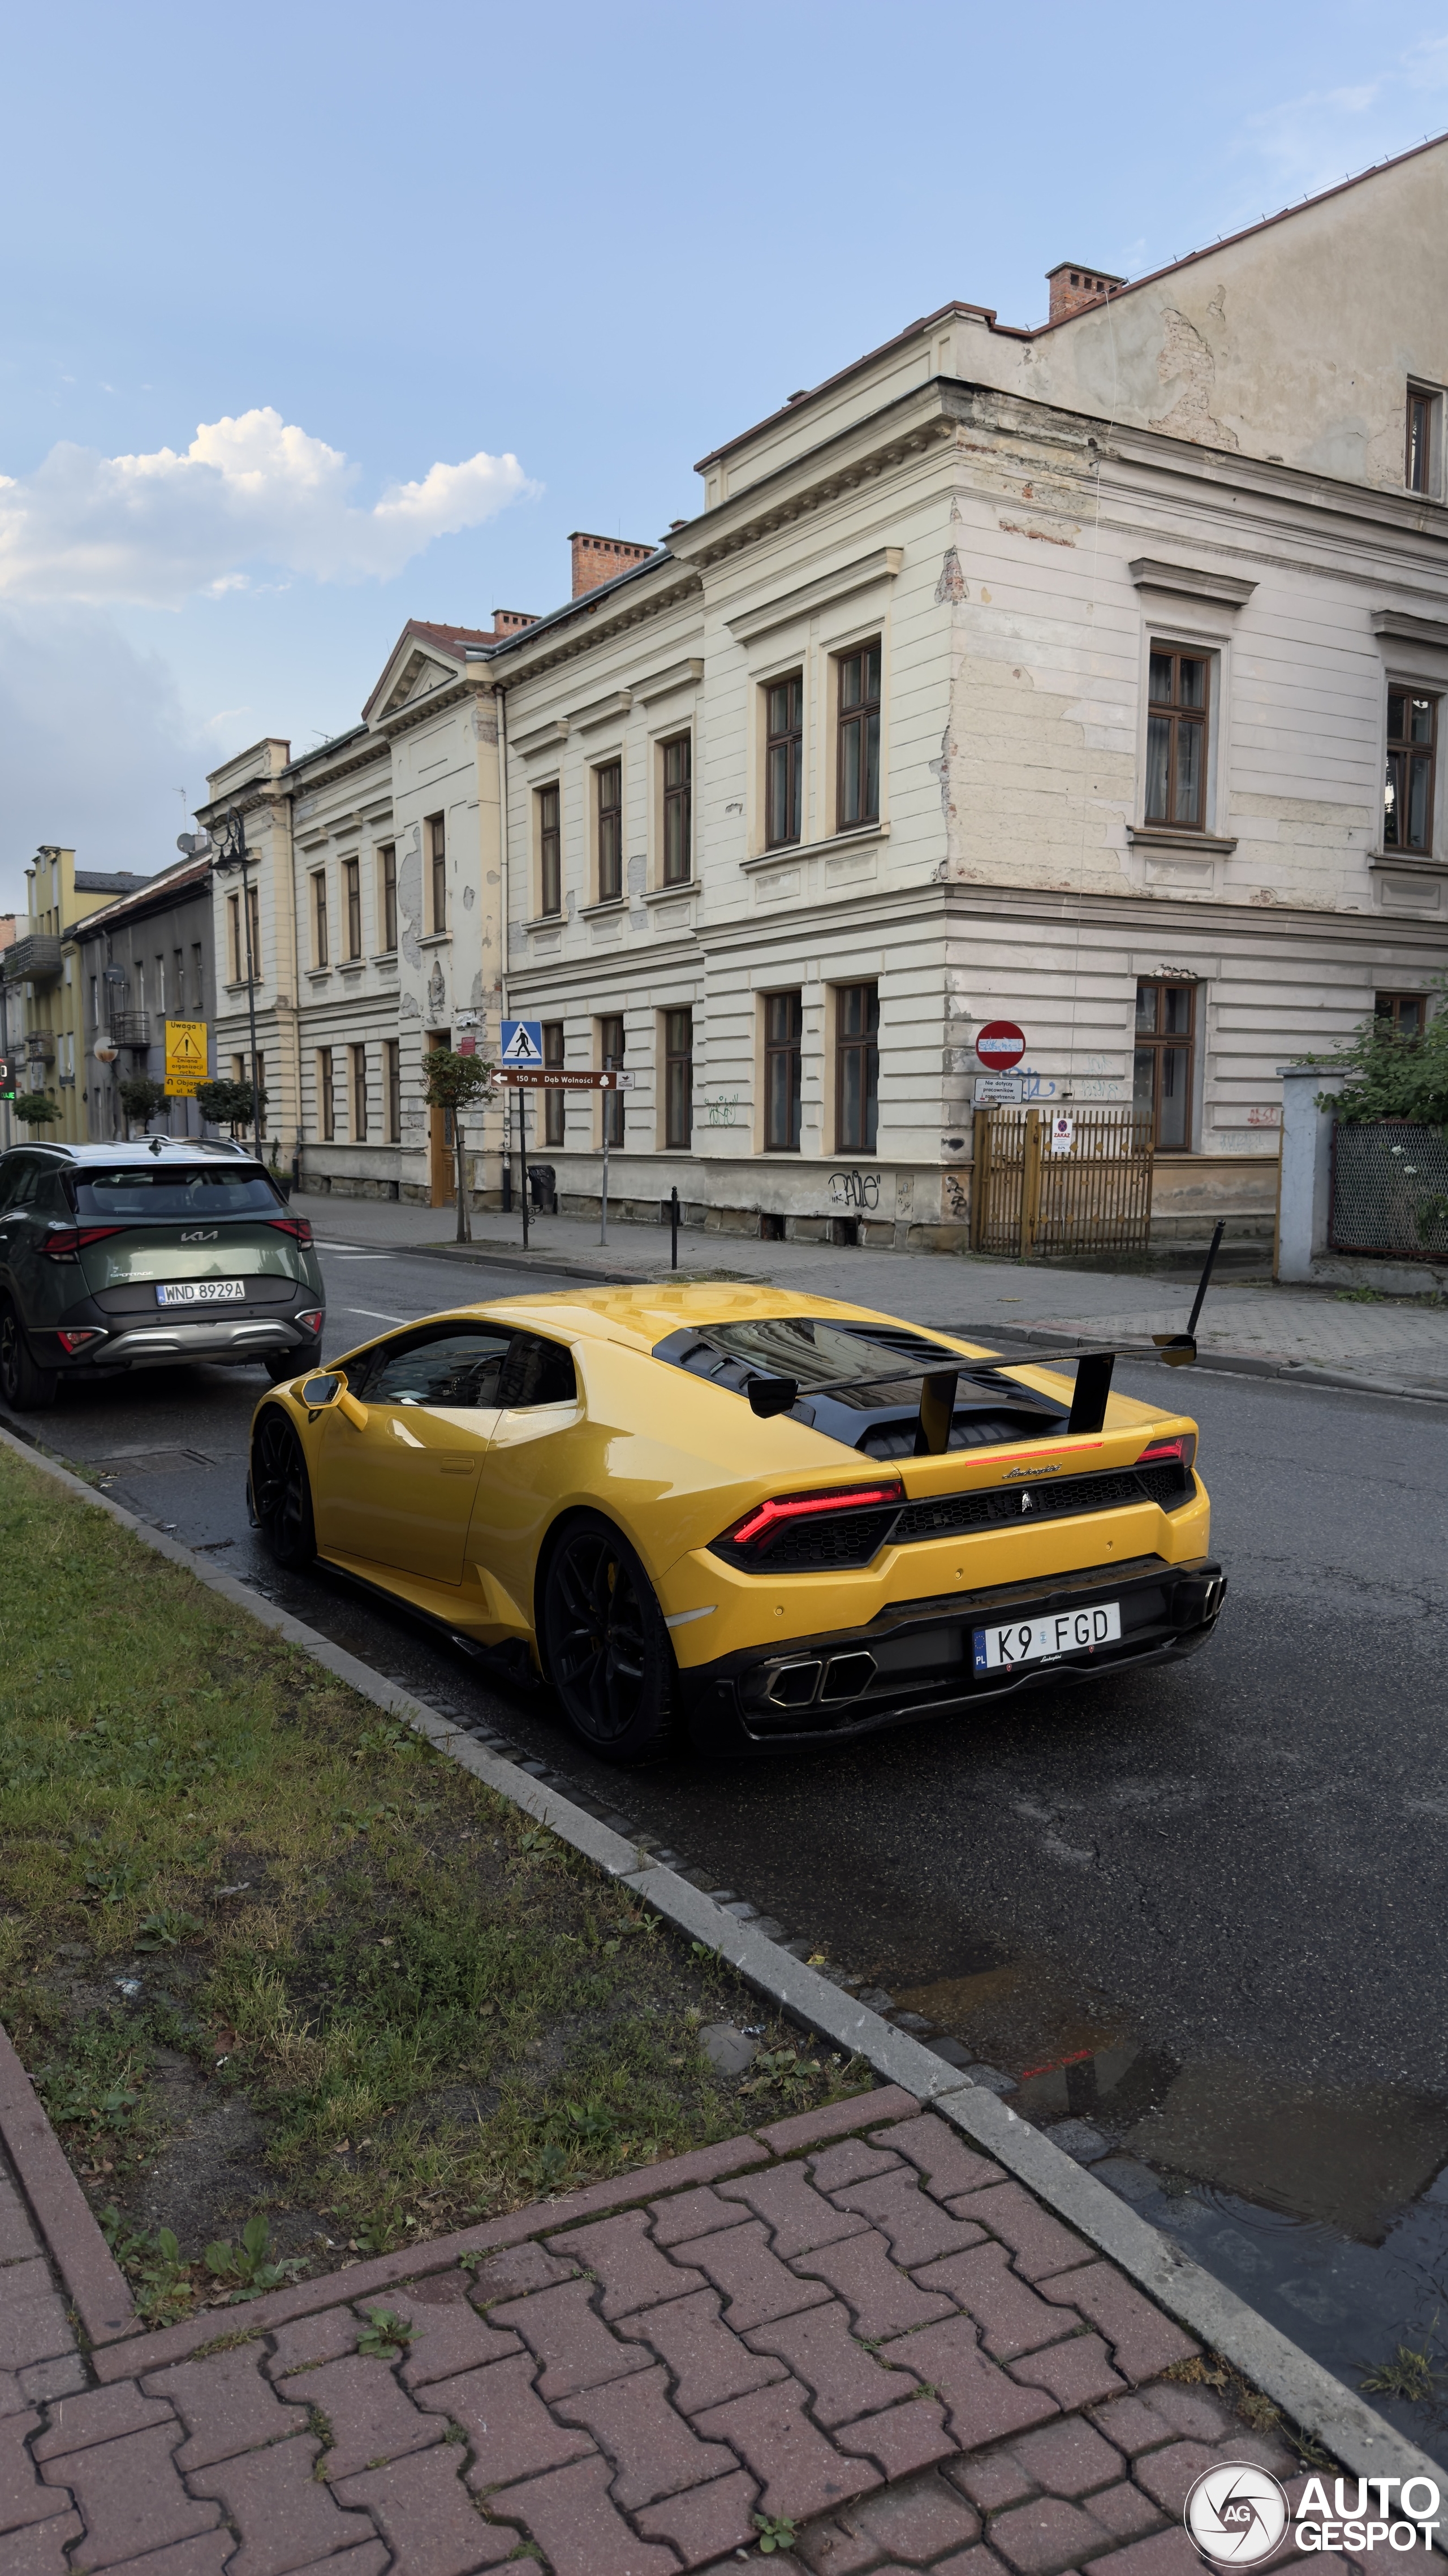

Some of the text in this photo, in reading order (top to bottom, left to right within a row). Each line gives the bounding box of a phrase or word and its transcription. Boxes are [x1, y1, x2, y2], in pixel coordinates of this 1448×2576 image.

[171, 1022, 196, 1030] Uwaga
[181, 1231, 218, 1241] KIA
[166, 1283, 243, 1301] WND 8929A
[1002, 1462, 1063, 1479] Lamborghini
[998, 1610, 1107, 1663] K9 FGD
[976, 1656, 985, 1665] PL
[1040, 1654, 1062, 1663] Lamborghini
